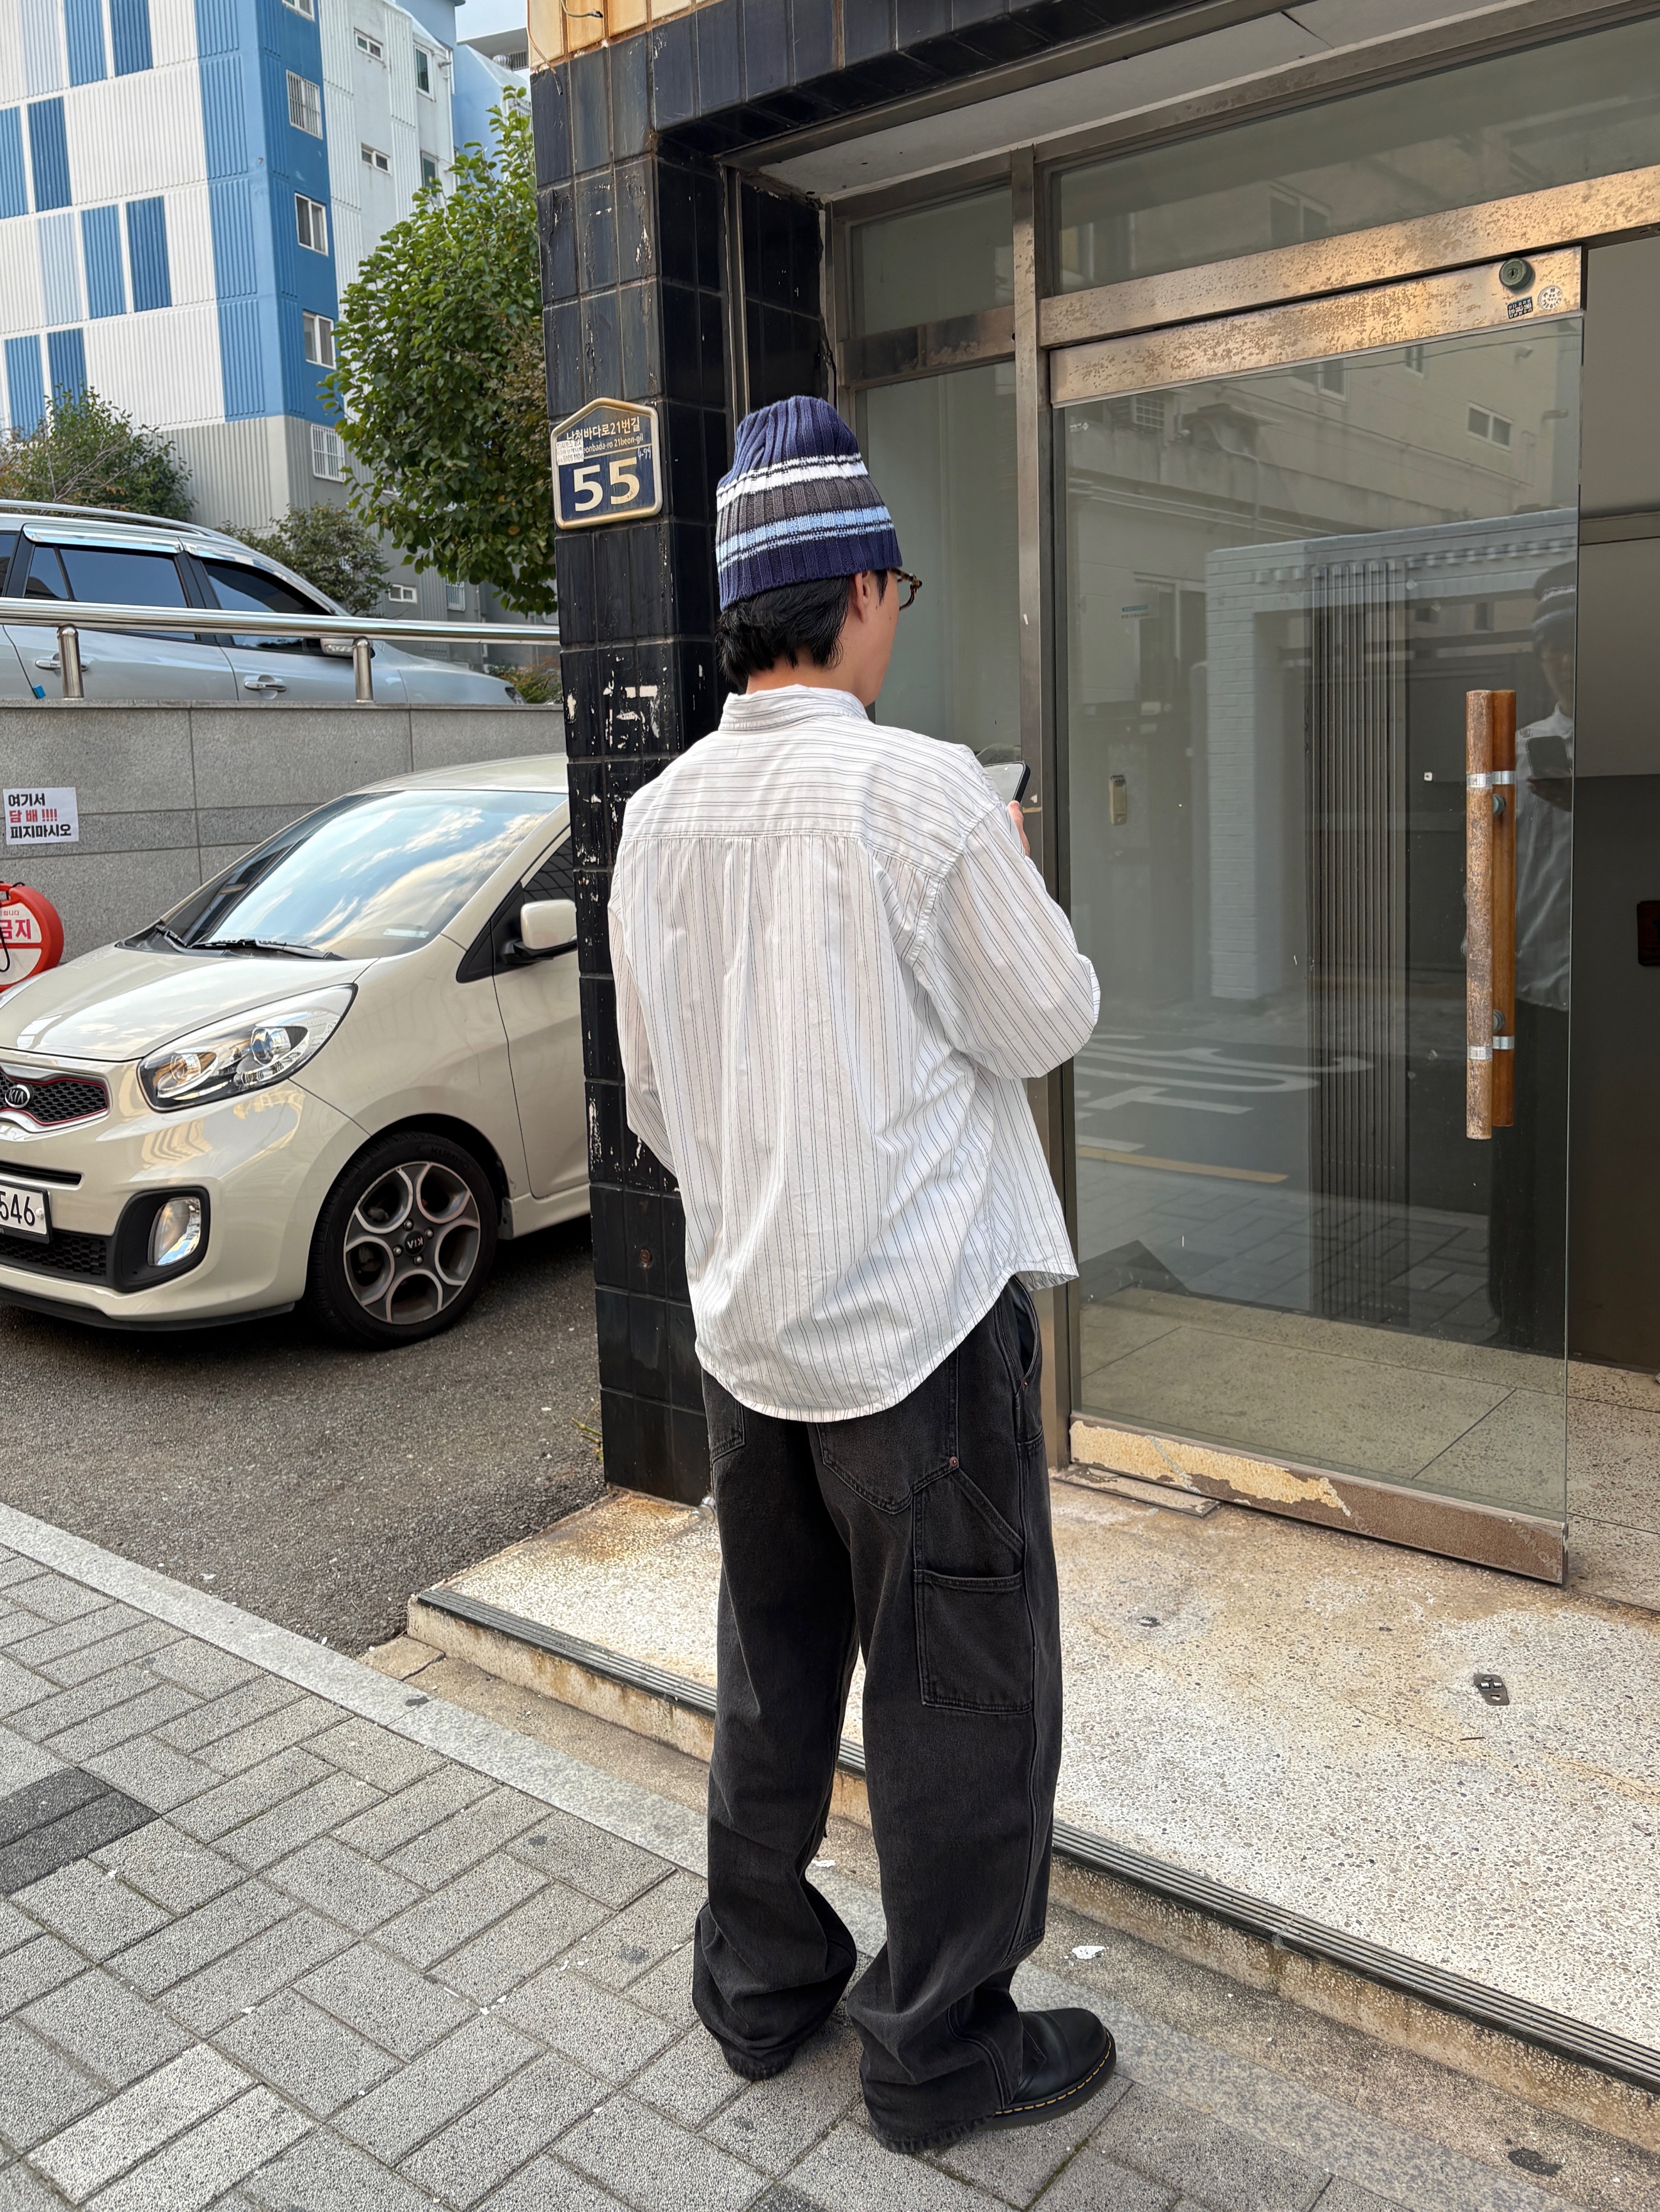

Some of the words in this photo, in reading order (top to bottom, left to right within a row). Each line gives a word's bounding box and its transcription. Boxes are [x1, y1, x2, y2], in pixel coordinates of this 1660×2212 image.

[573, 456, 640, 512] 55
[8, 793, 46, 807] 여기서
[10, 824, 72, 839] 피지마시오
[0, 919, 31, 940] 금지
[8, 1089, 24, 1104] KIA
[0, 1191, 35, 1227] 546
[407, 1236, 423, 1249] KIA
